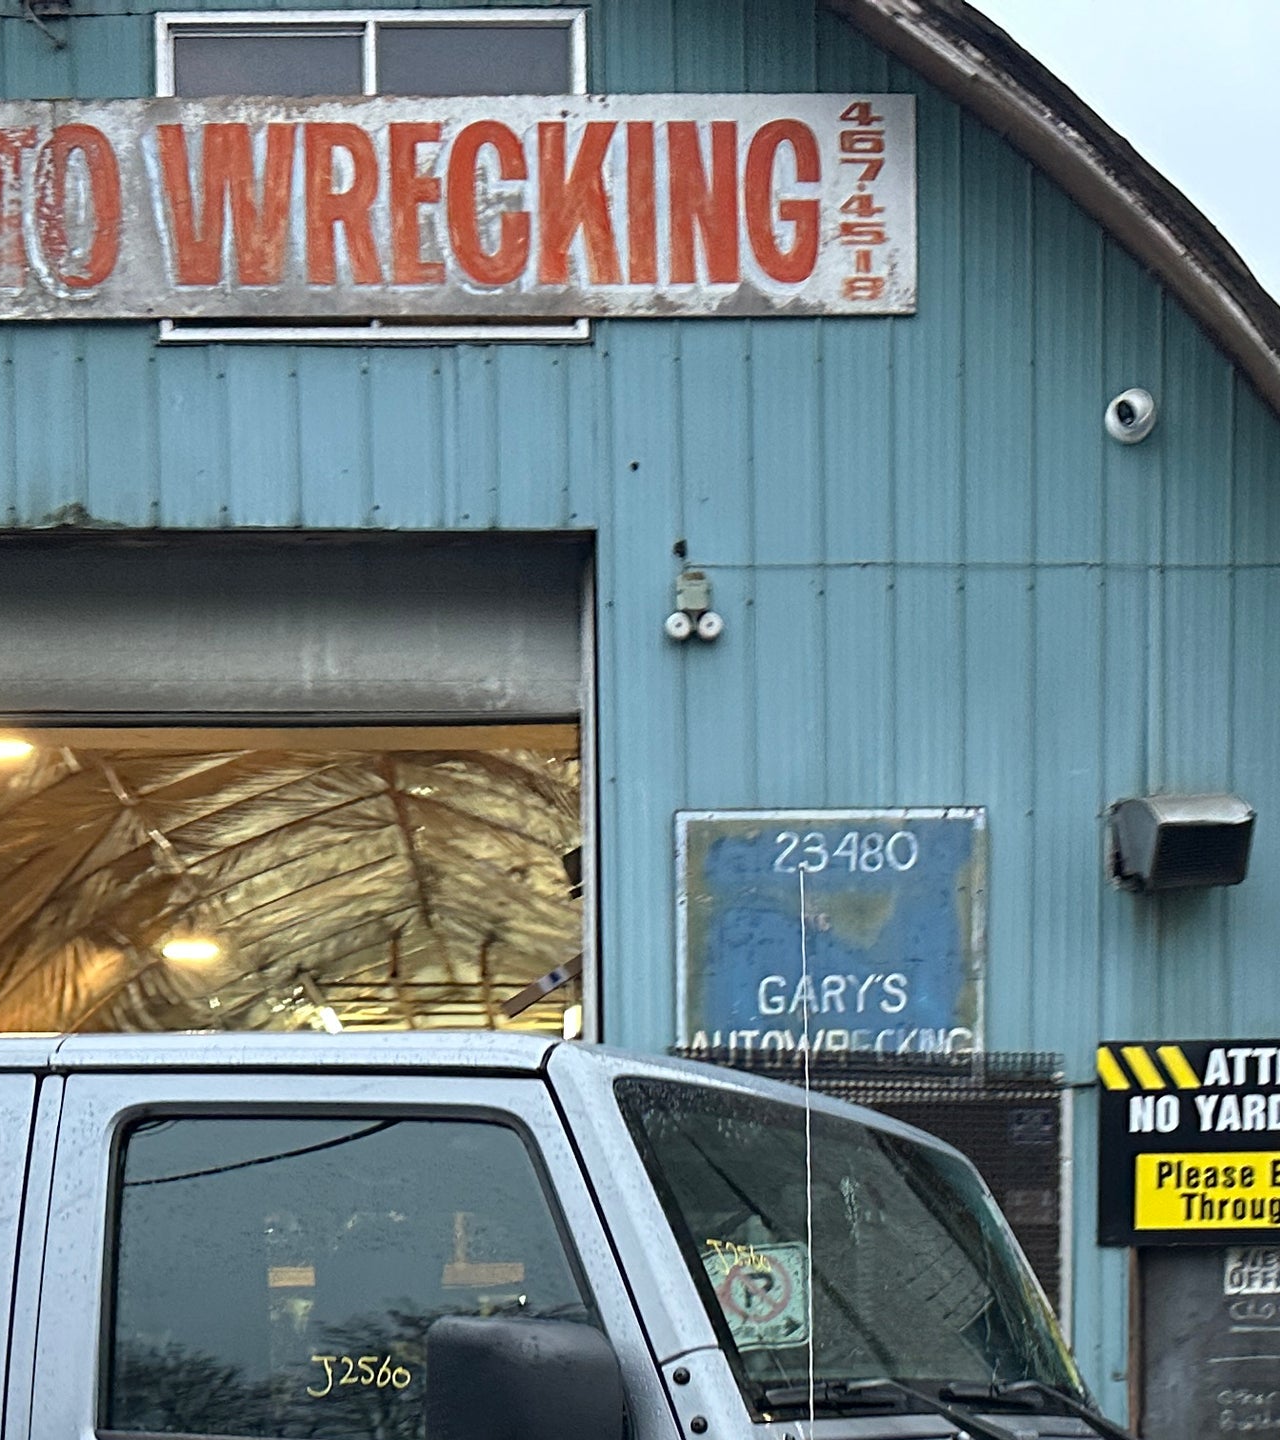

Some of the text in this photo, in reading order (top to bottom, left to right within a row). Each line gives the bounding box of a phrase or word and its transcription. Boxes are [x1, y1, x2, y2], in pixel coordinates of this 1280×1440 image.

[156, 118, 822, 286] WRECKING
[773, 831, 918, 873] 23480
[757, 972, 909, 1015] GARY'S
[1128, 1094, 1180, 1133] NO
[1156, 1160, 1255, 1190] Please
[306, 1354, 412, 1398] J2560
